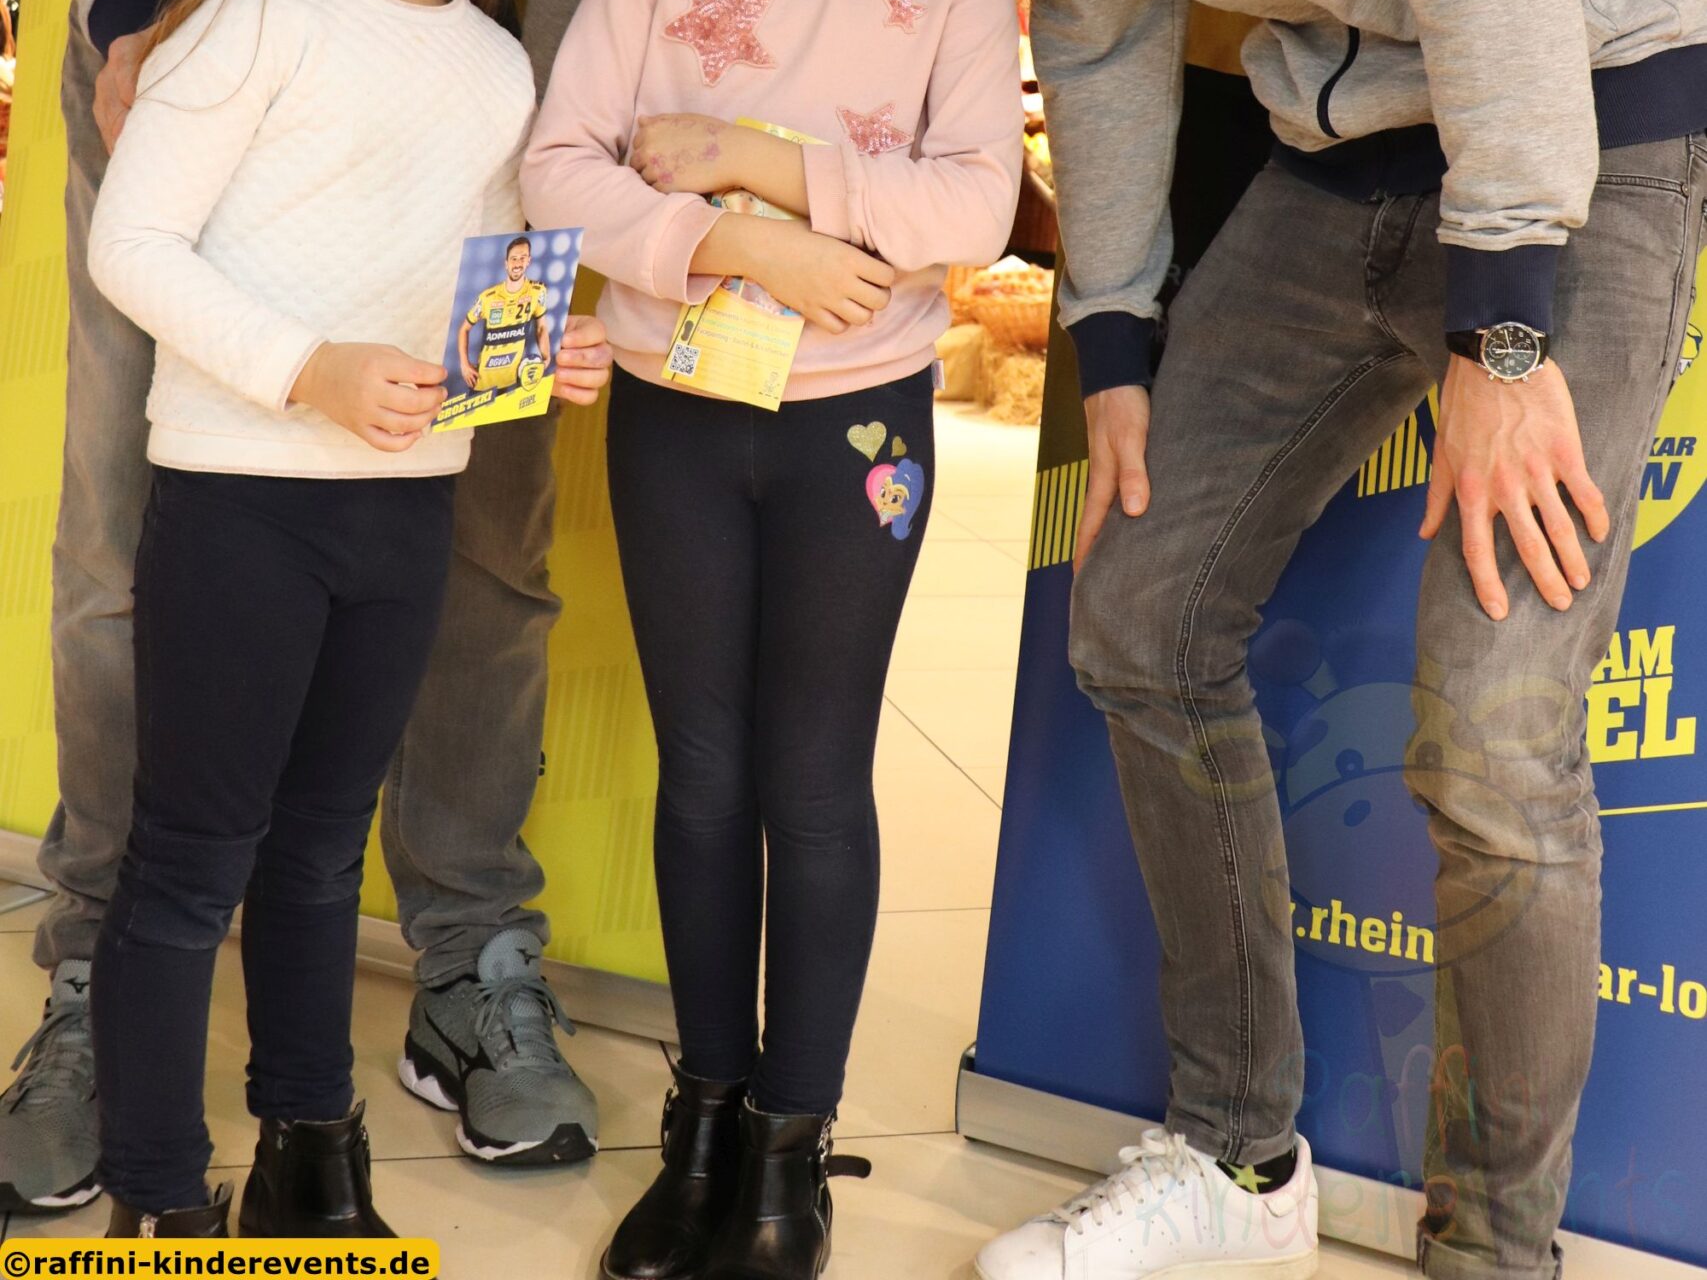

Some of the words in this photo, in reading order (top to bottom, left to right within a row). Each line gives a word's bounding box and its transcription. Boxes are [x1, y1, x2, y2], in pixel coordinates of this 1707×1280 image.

[515, 302, 531, 320] 24
[486, 326, 526, 342] ADMIRAL
[1290, 898, 1435, 964] .rhein
